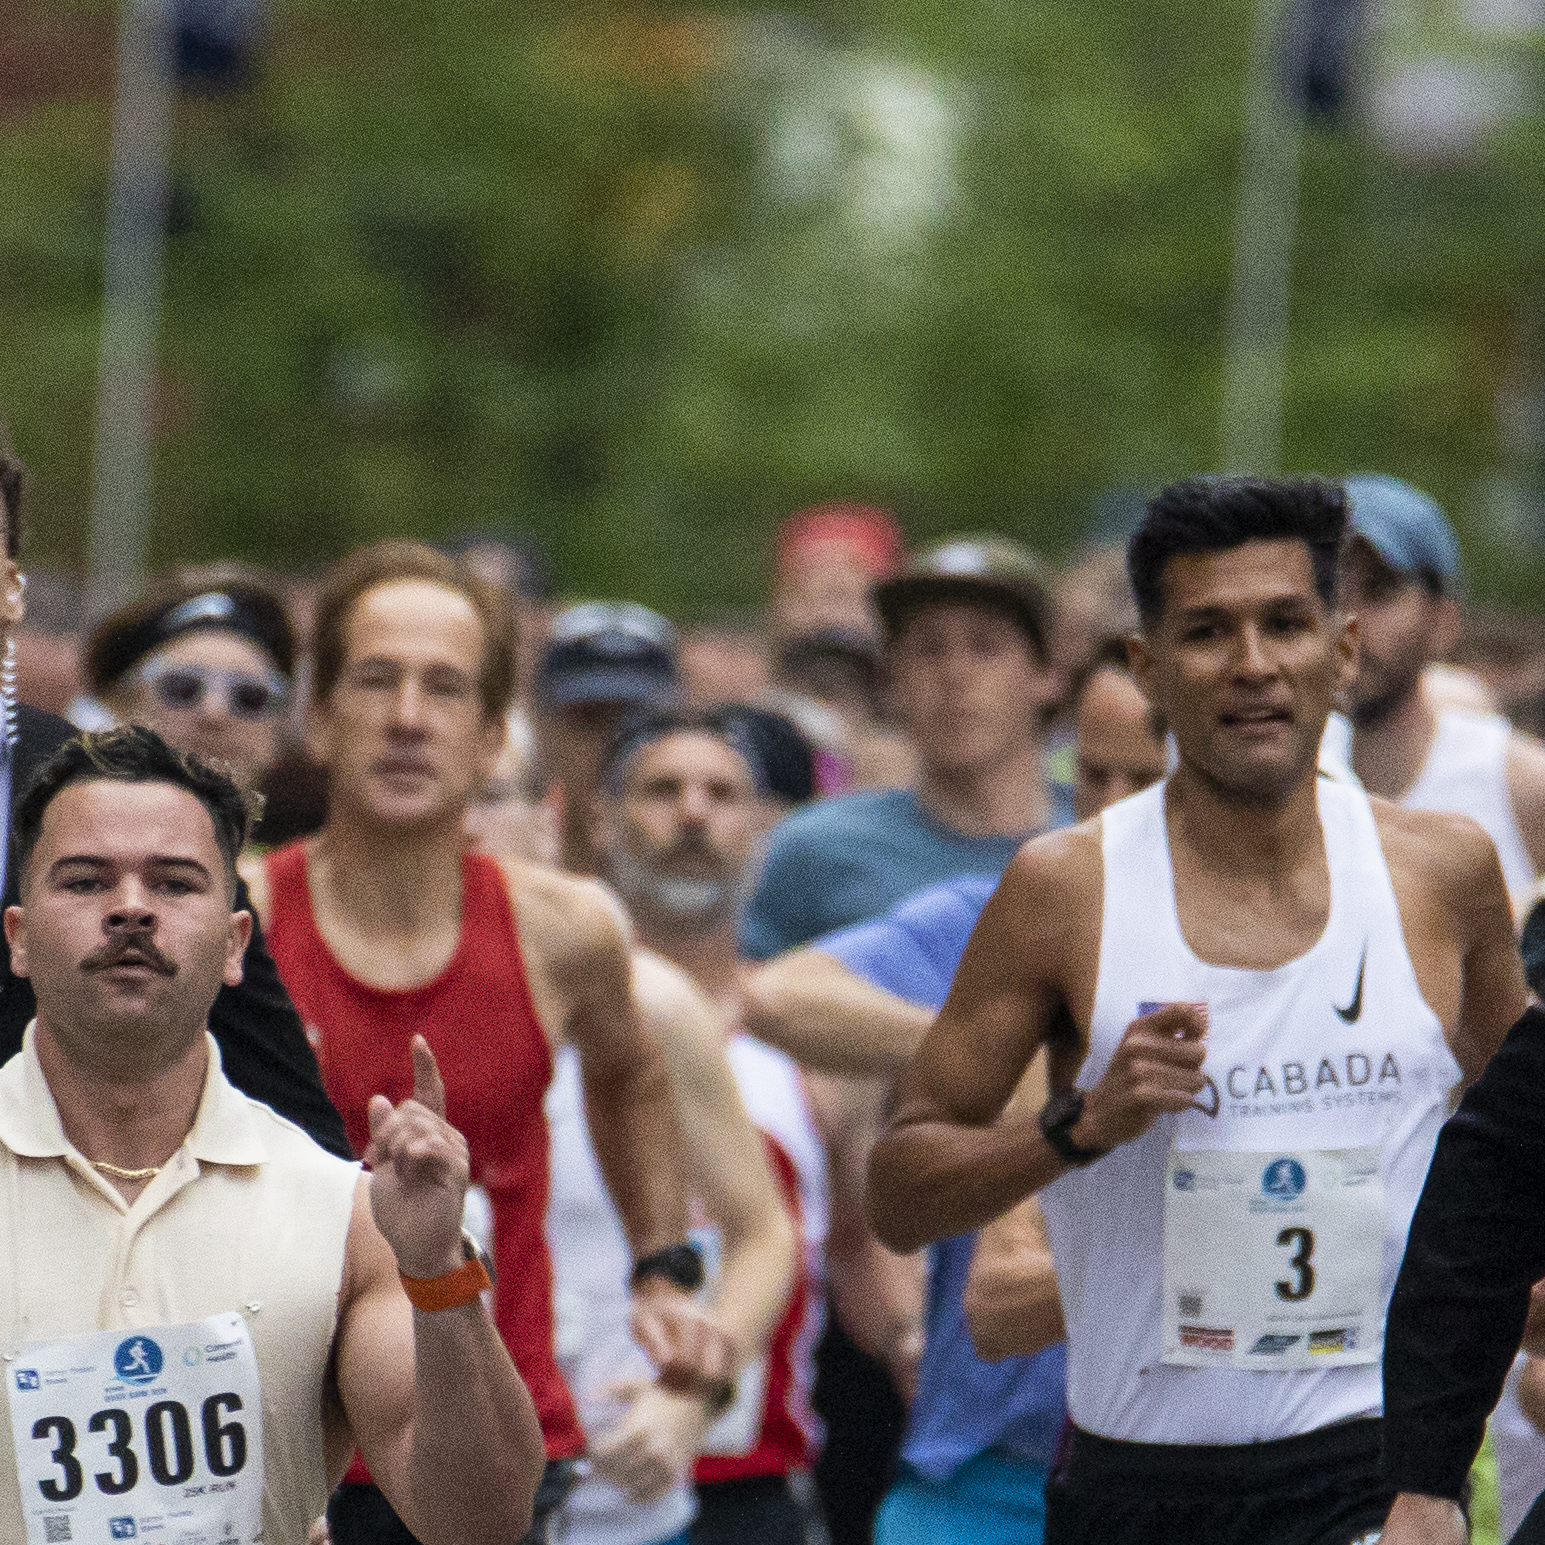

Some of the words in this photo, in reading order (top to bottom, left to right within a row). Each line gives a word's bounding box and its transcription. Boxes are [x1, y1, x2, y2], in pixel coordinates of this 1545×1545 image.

[1227, 1053, 1402, 1099] CABADA
[1275, 1226, 1317, 1302] 3
[32, 1392, 248, 1502] 3306
